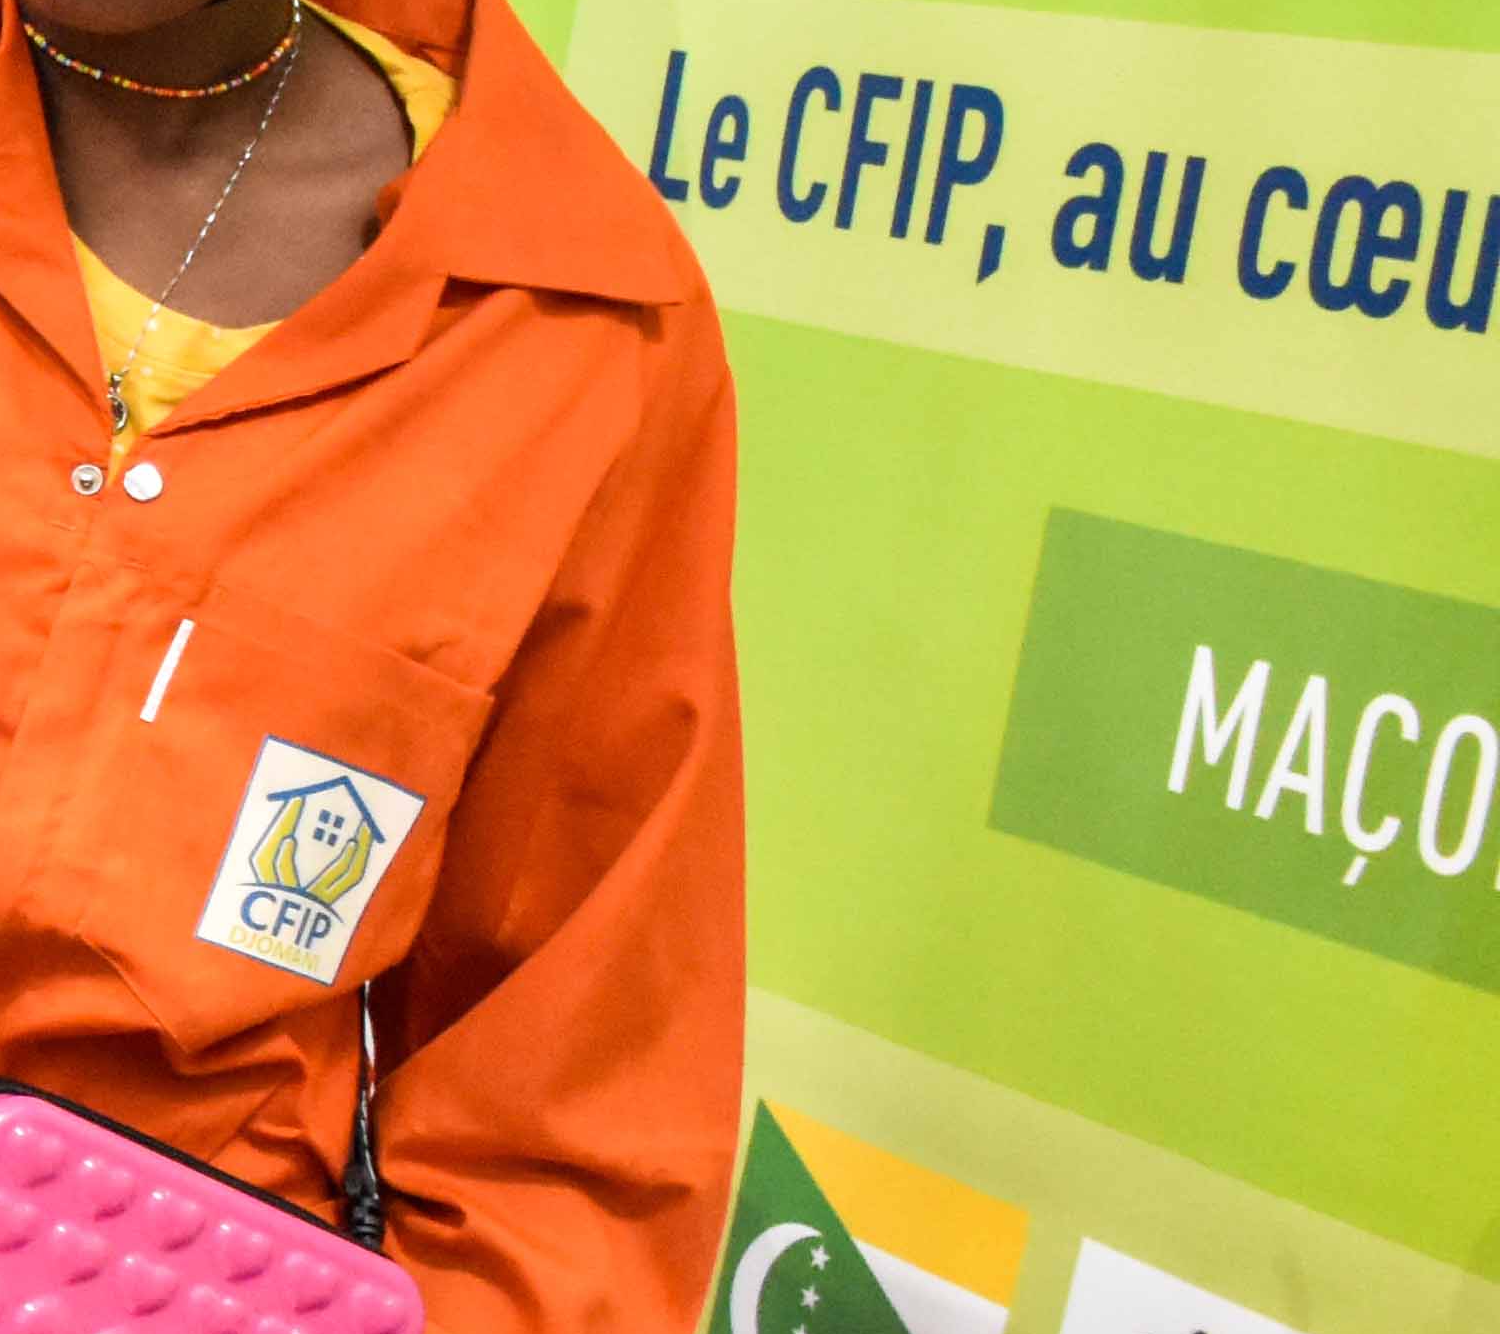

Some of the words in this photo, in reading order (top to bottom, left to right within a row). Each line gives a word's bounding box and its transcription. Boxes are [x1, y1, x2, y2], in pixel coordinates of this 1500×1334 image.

[647, 49, 750, 211] Le
[775, 63, 1007, 285] CFIP,
[1049, 142, 1208, 284] au
[1166, 643, 1500, 888] MAÇO
[240, 889, 333, 950] CFIP
